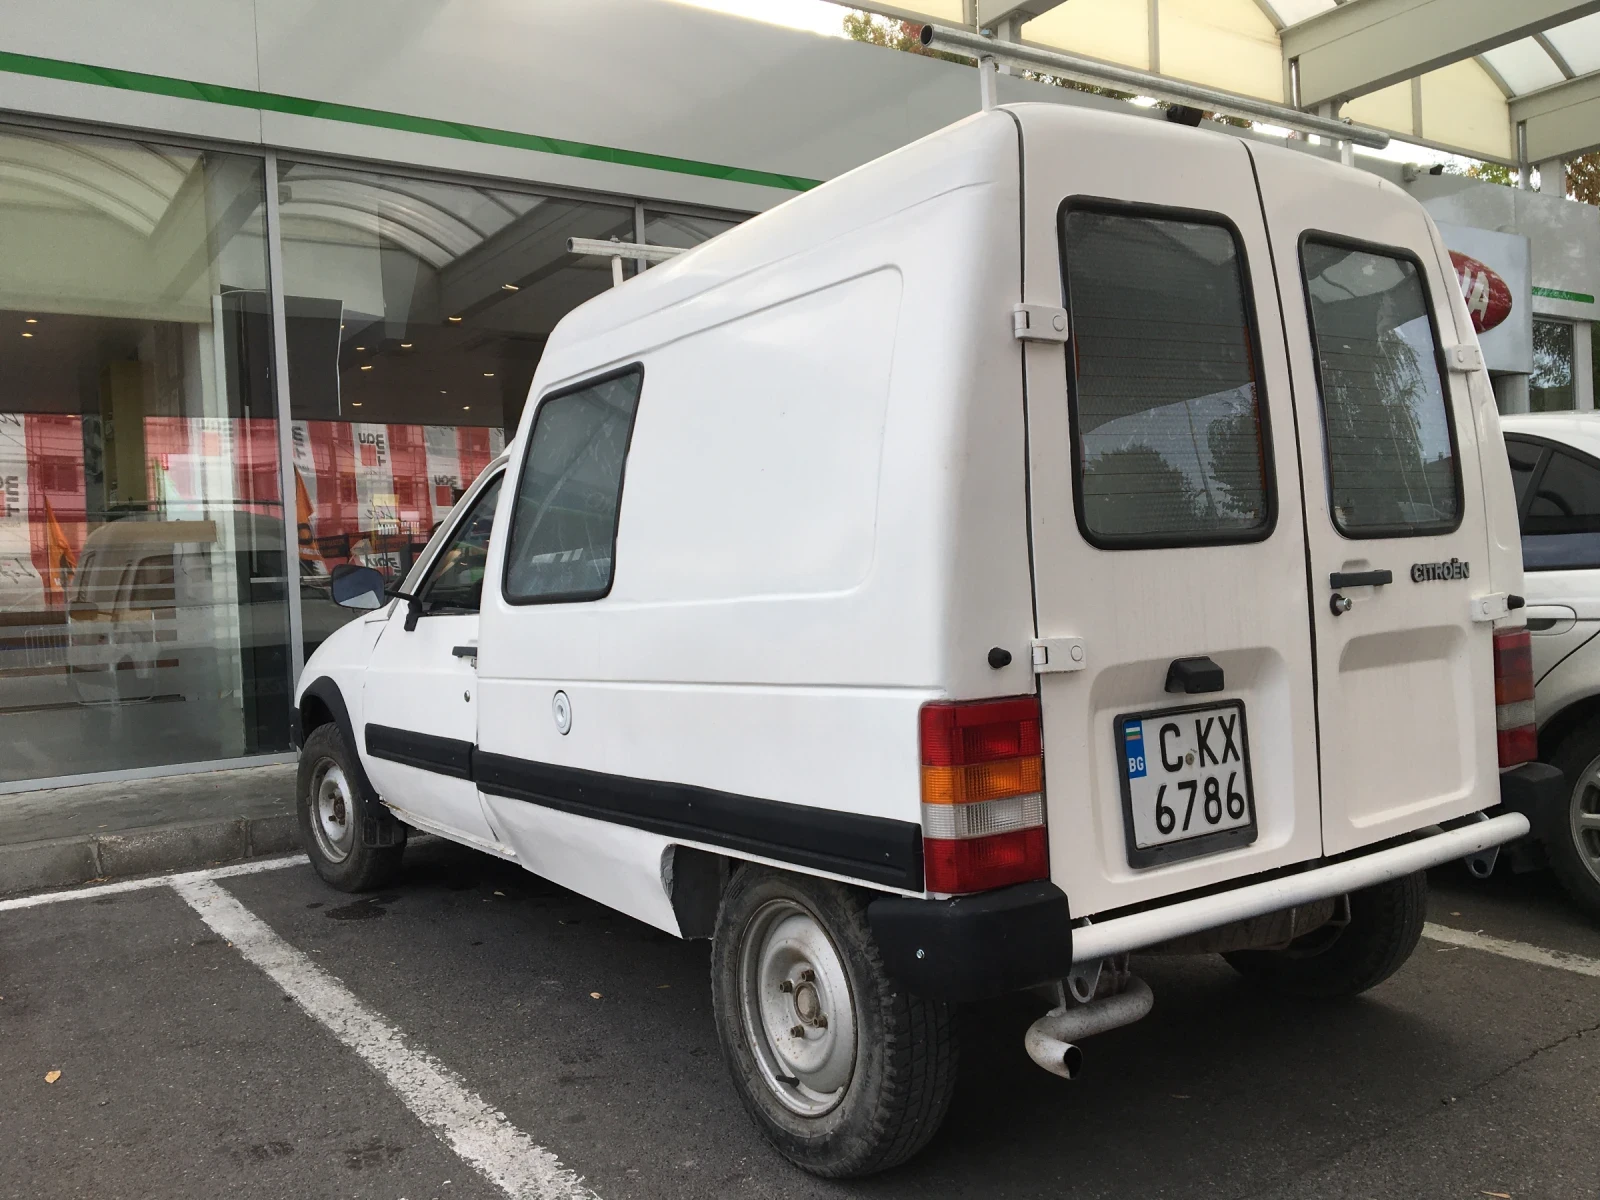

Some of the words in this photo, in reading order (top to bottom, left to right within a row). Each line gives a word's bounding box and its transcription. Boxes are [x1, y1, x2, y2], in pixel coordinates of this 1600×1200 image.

[1410, 557, 1470, 583] CITROËN
[1128, 756, 1145, 773] BG
[1155, 771, 1245, 835] 6786
